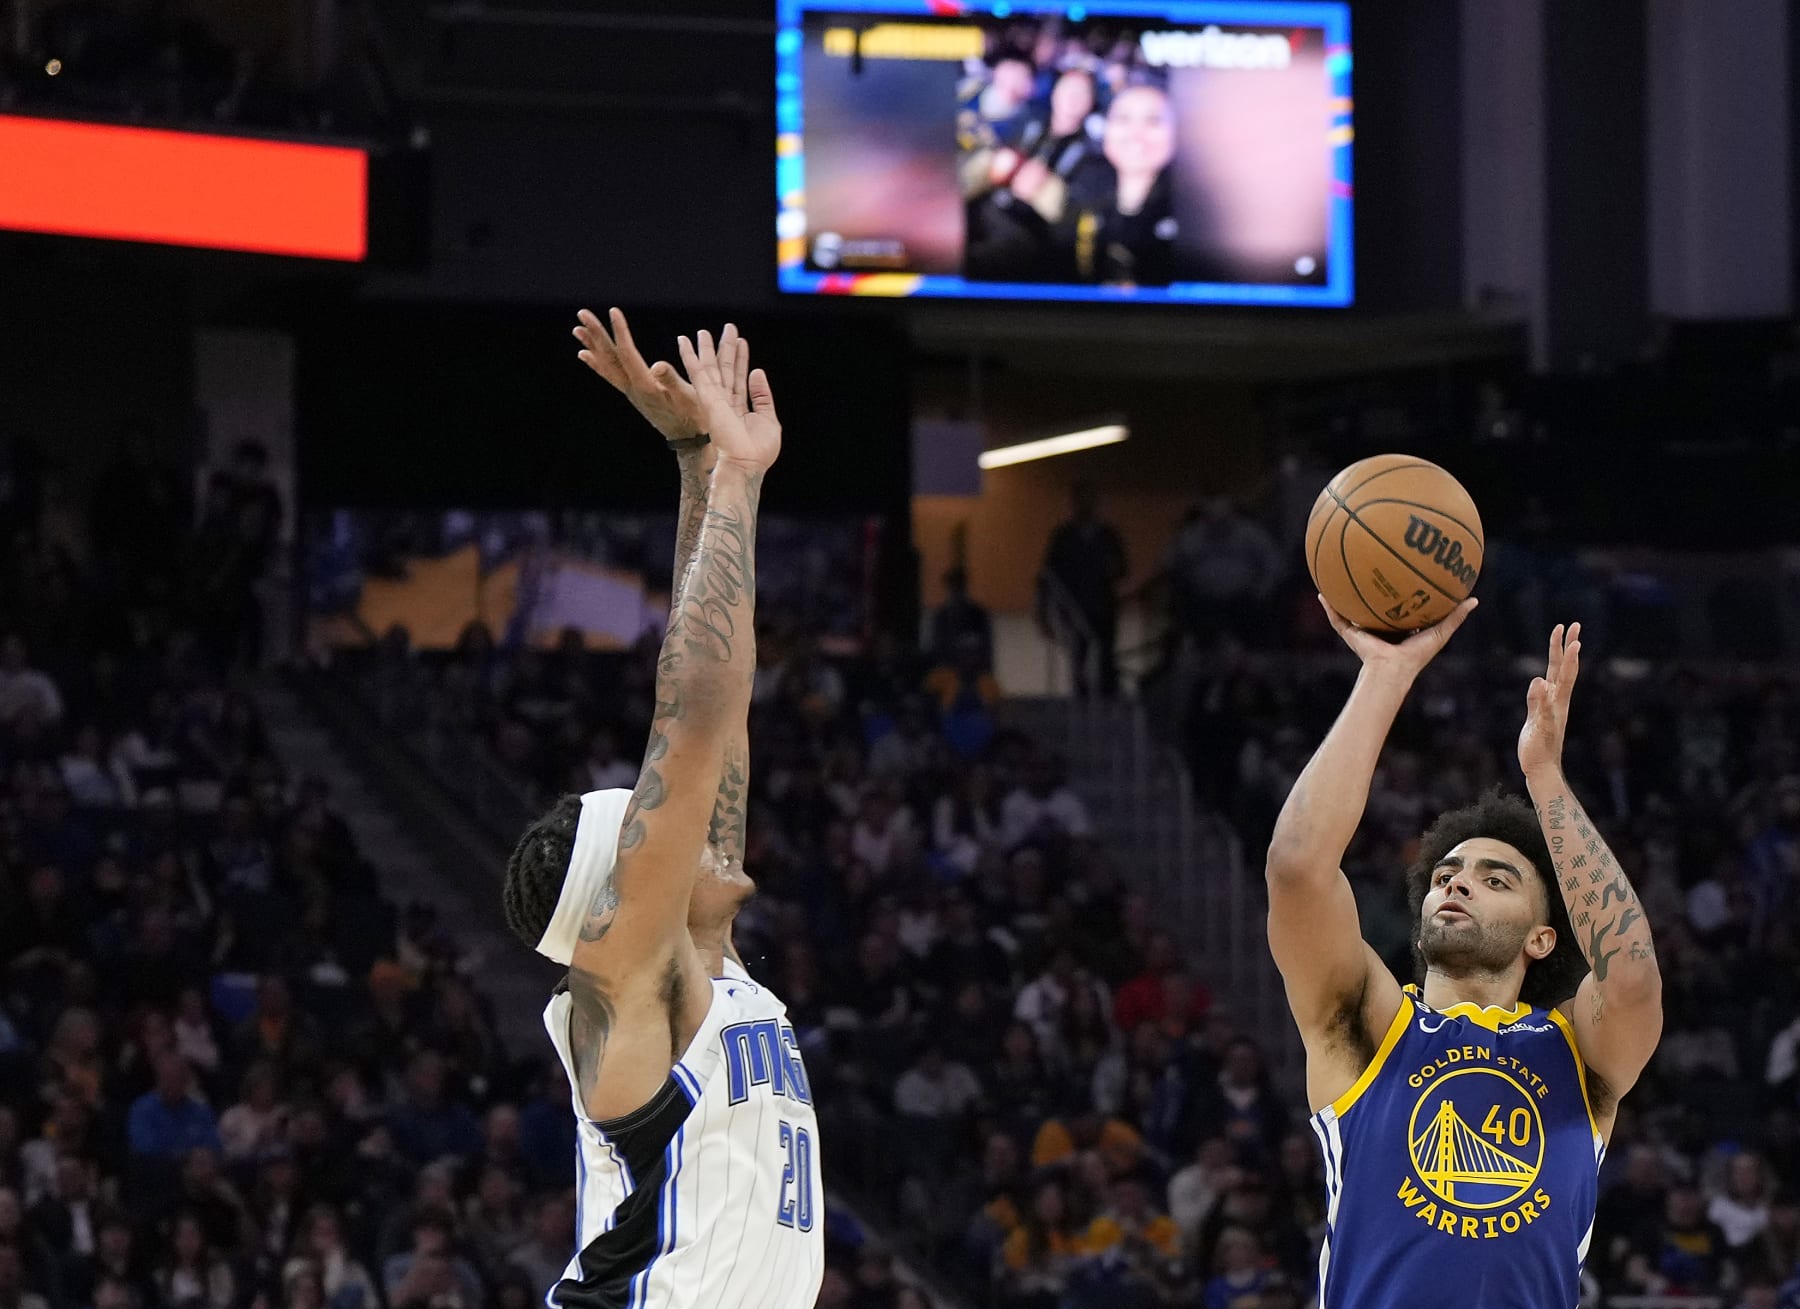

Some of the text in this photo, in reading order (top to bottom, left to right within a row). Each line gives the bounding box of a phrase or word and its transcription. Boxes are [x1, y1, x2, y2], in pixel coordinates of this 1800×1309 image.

[1498, 1023, 1553, 1036] Rakuten
[1408, 1045, 1549, 1100] GOLDEN STATE
[1481, 1104, 1531, 1147] 40
[777, 1119, 814, 1233] 20
[1397, 1176, 1551, 1239] WARRIORS
